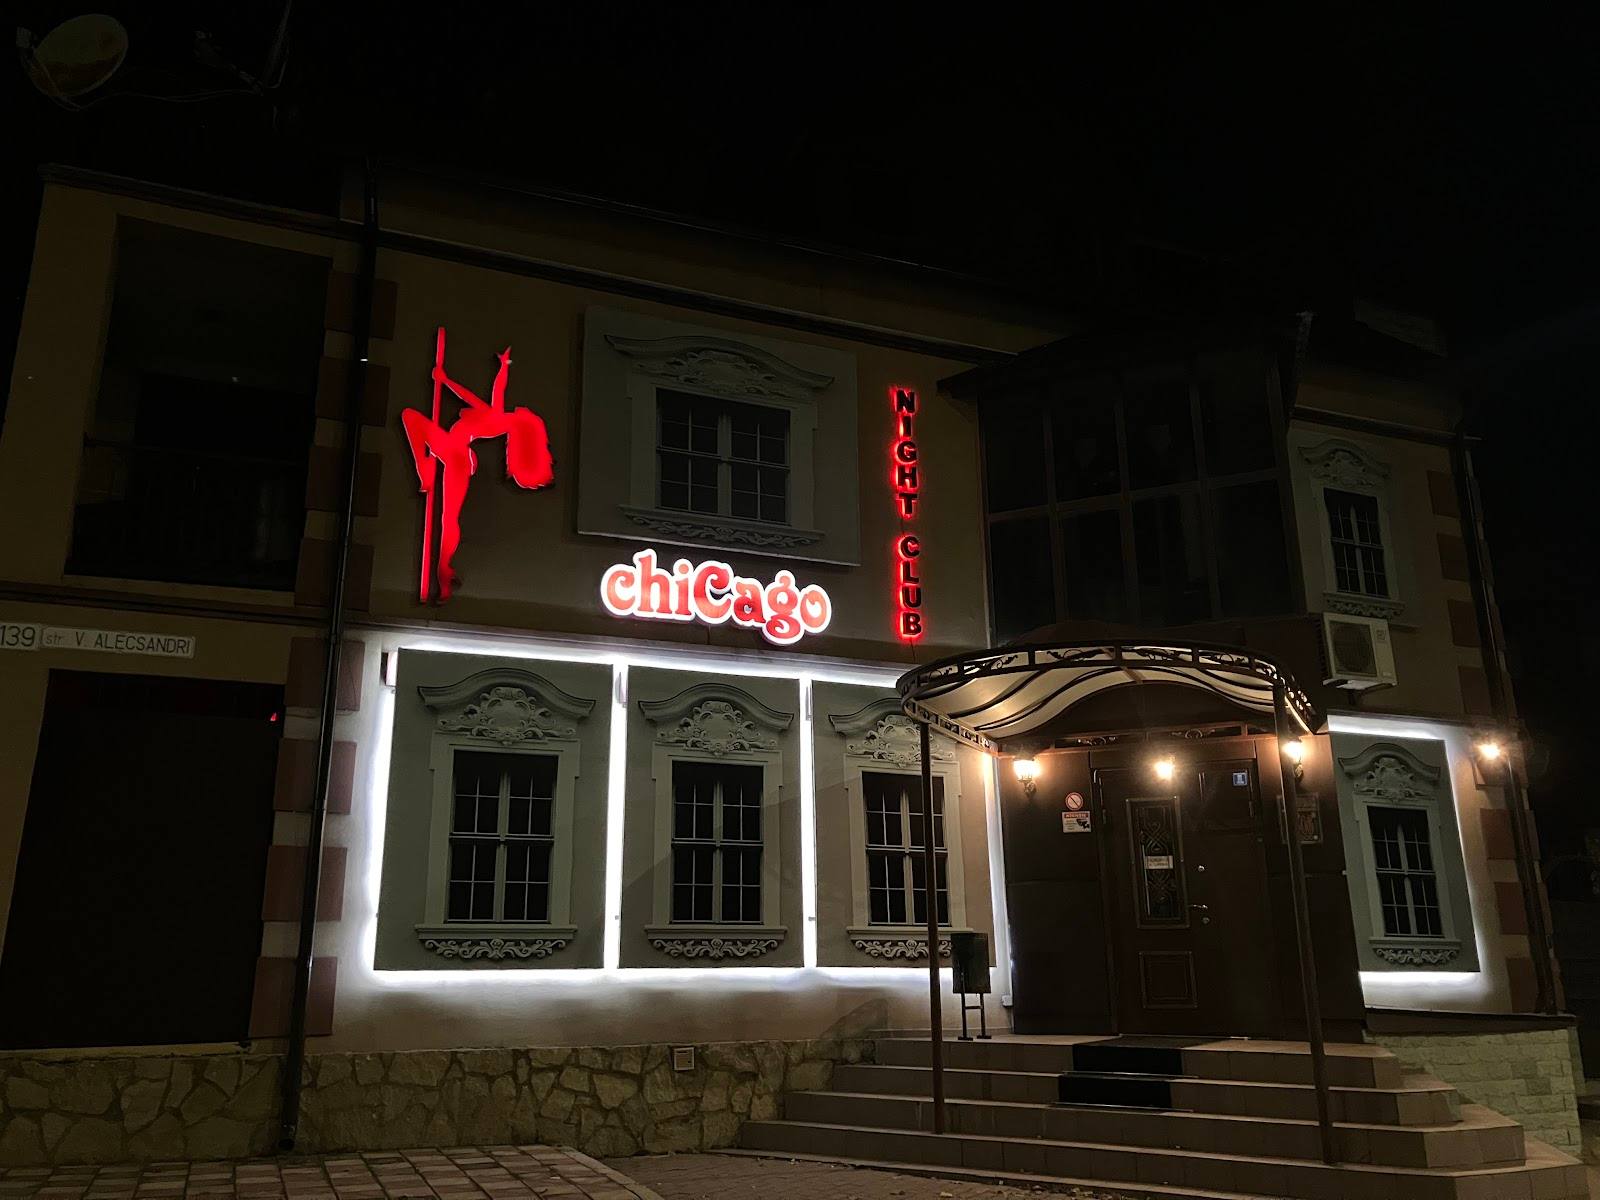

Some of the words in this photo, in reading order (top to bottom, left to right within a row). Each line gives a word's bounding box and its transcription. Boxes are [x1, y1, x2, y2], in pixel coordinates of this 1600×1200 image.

[894, 388, 918, 515] NIGHT
[603, 550, 830, 643] chiCago
[899, 535, 922, 637] CLUB
[0, 625, 37, 647] 139
[94, 633, 191, 656] ALECSANDRI
